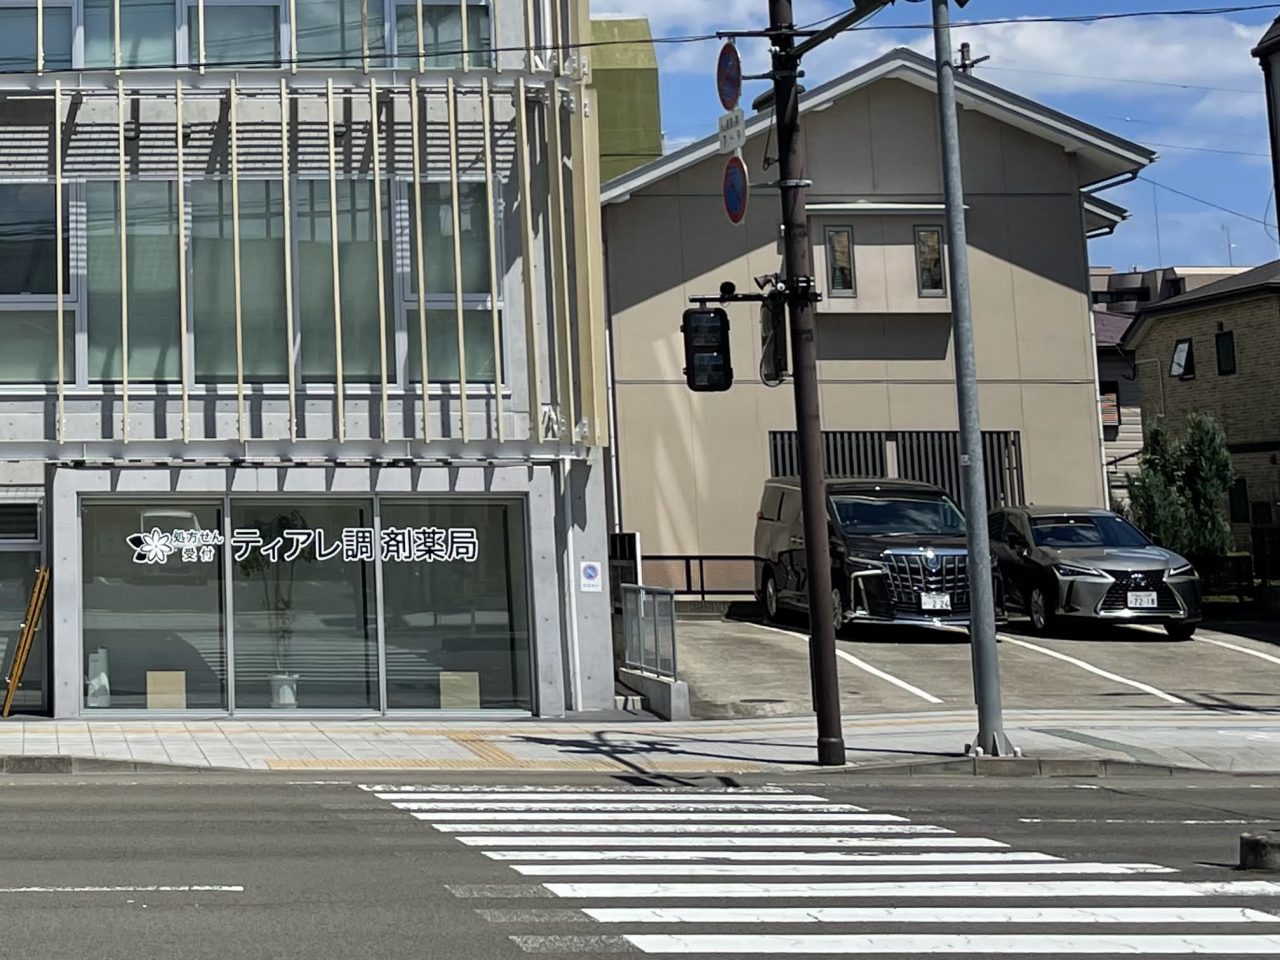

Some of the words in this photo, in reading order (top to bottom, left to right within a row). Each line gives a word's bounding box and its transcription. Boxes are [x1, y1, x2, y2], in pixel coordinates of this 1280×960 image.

[171, 528, 225, 545] 処方せん
[230, 528, 479, 562] ティアレ調剤薬局
[181, 545, 216, 562] 受付
